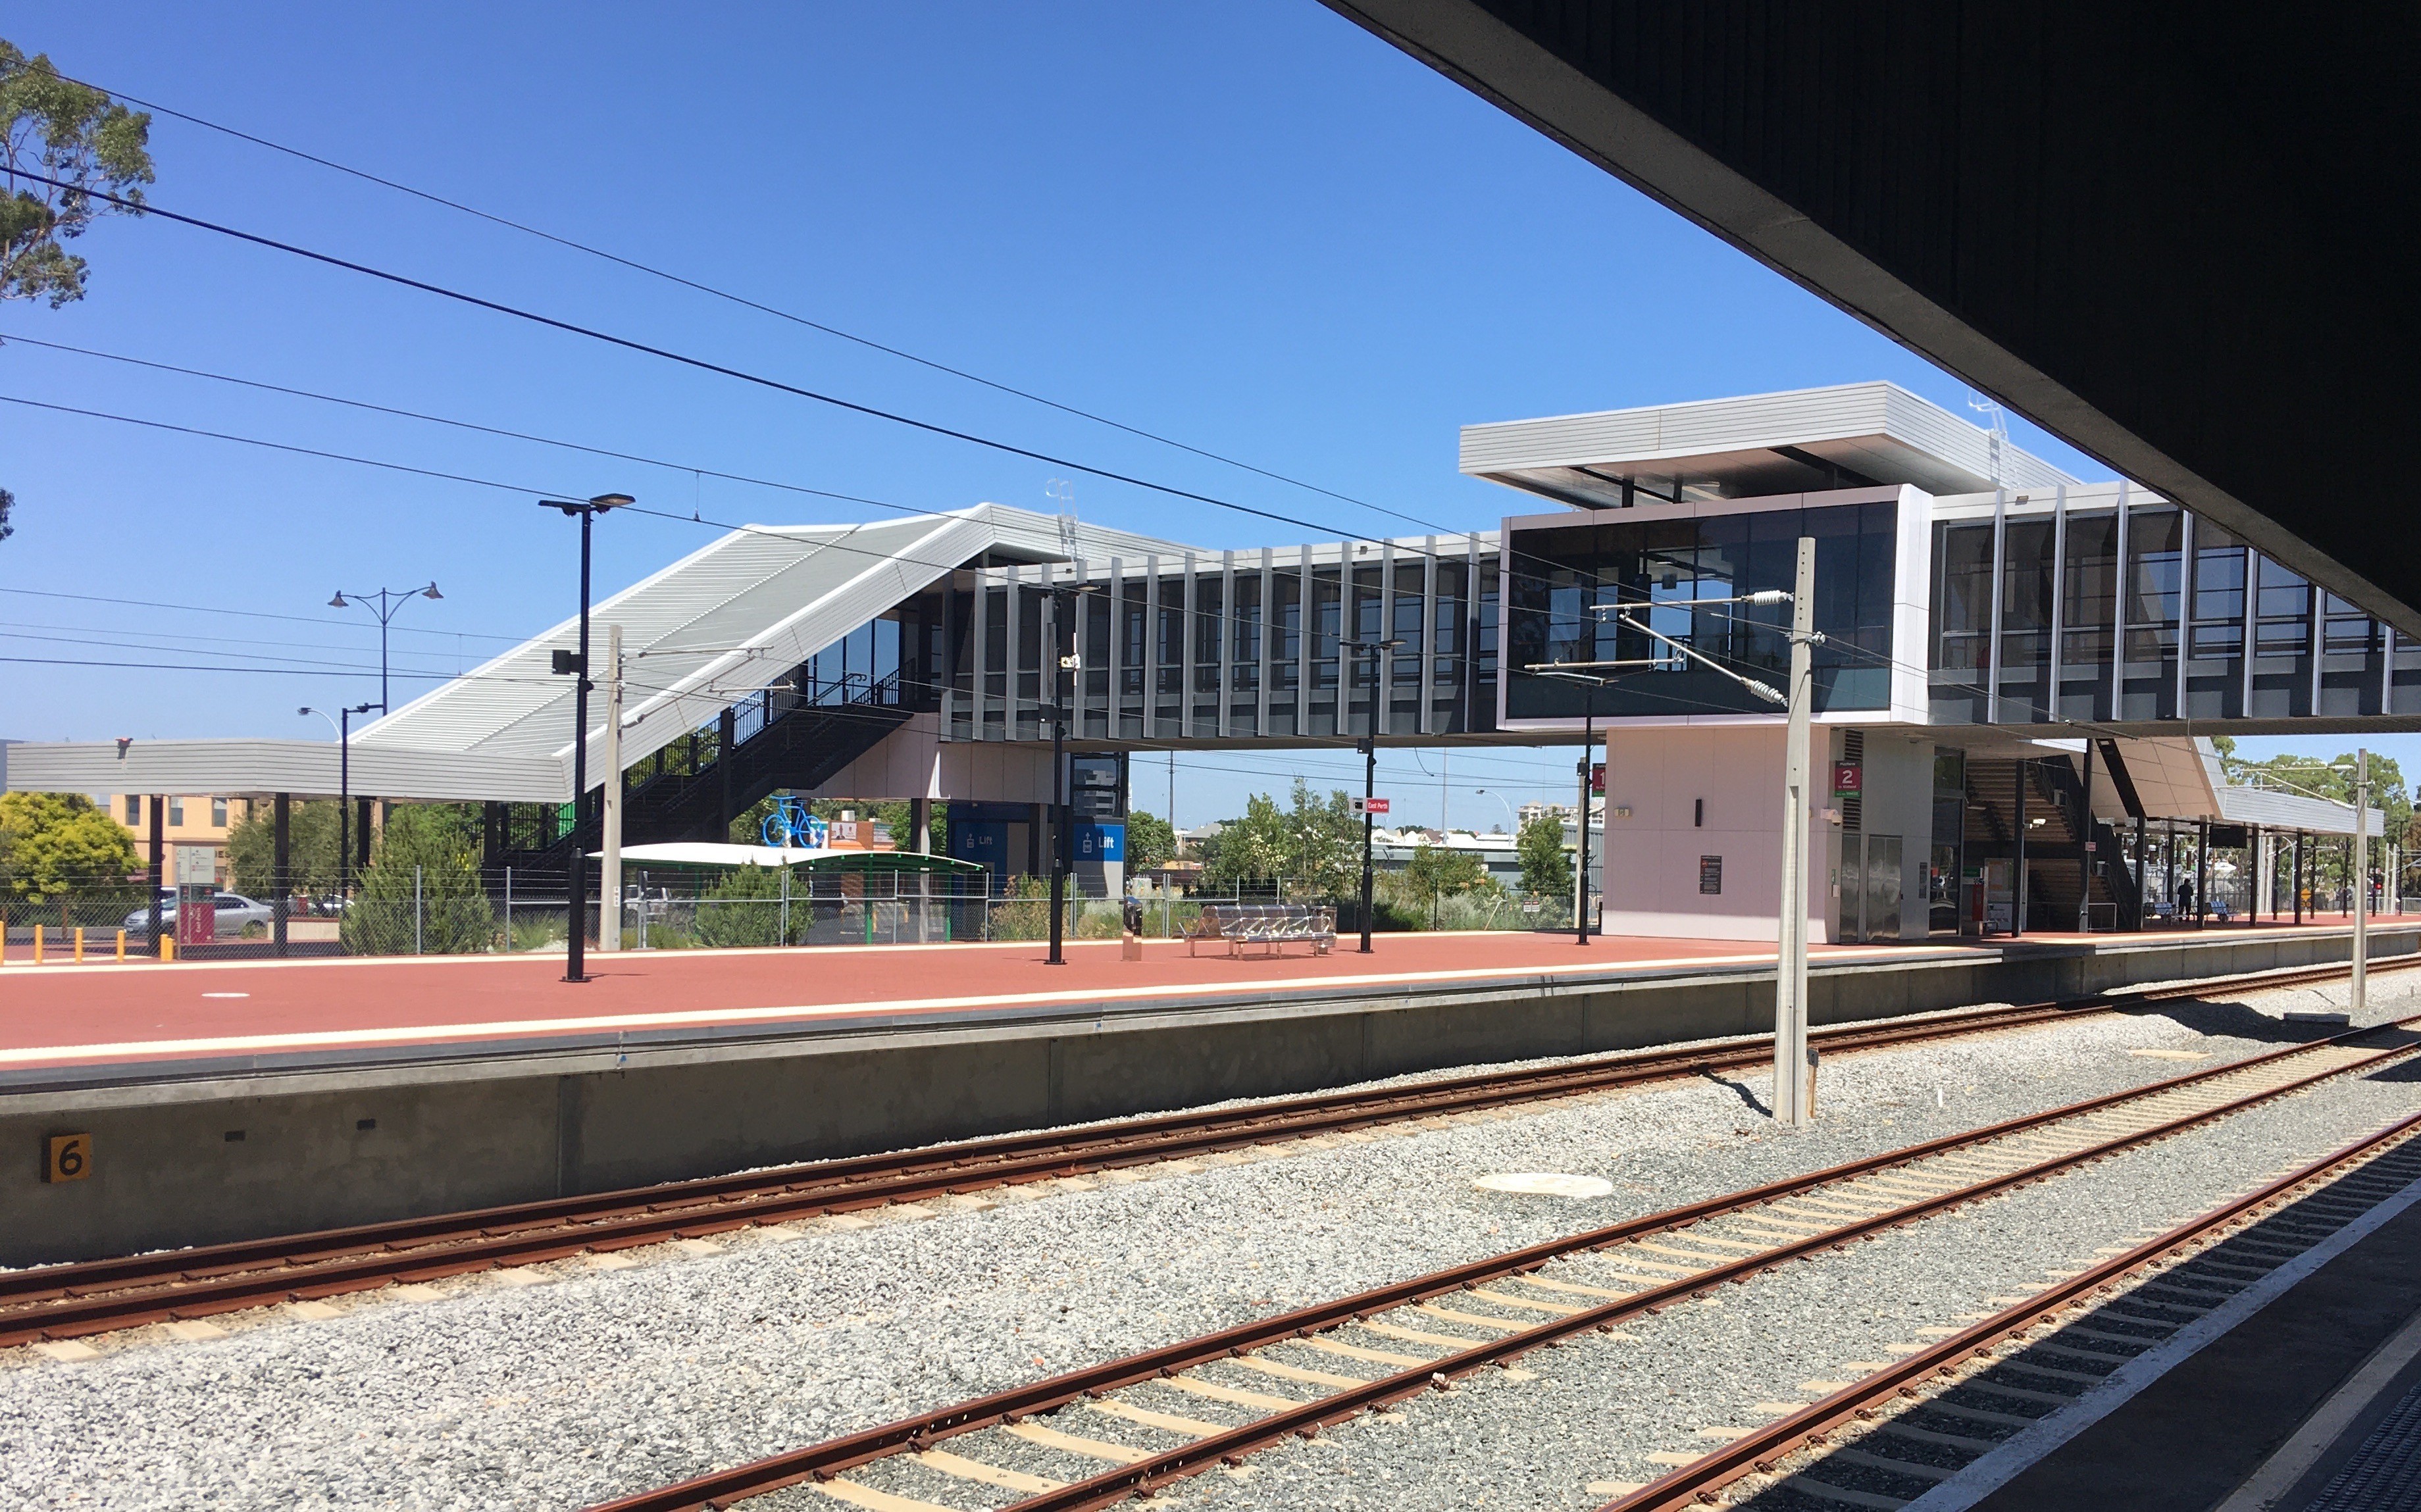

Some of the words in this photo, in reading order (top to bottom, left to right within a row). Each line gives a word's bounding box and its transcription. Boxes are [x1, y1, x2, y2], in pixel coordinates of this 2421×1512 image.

[1600, 772, 1605, 785] 1
[1842, 770, 1852, 784] 2
[979, 836, 992, 845] Lift
[1098, 836, 1114, 849] Lift
[59, 1140, 82, 1176] 6
